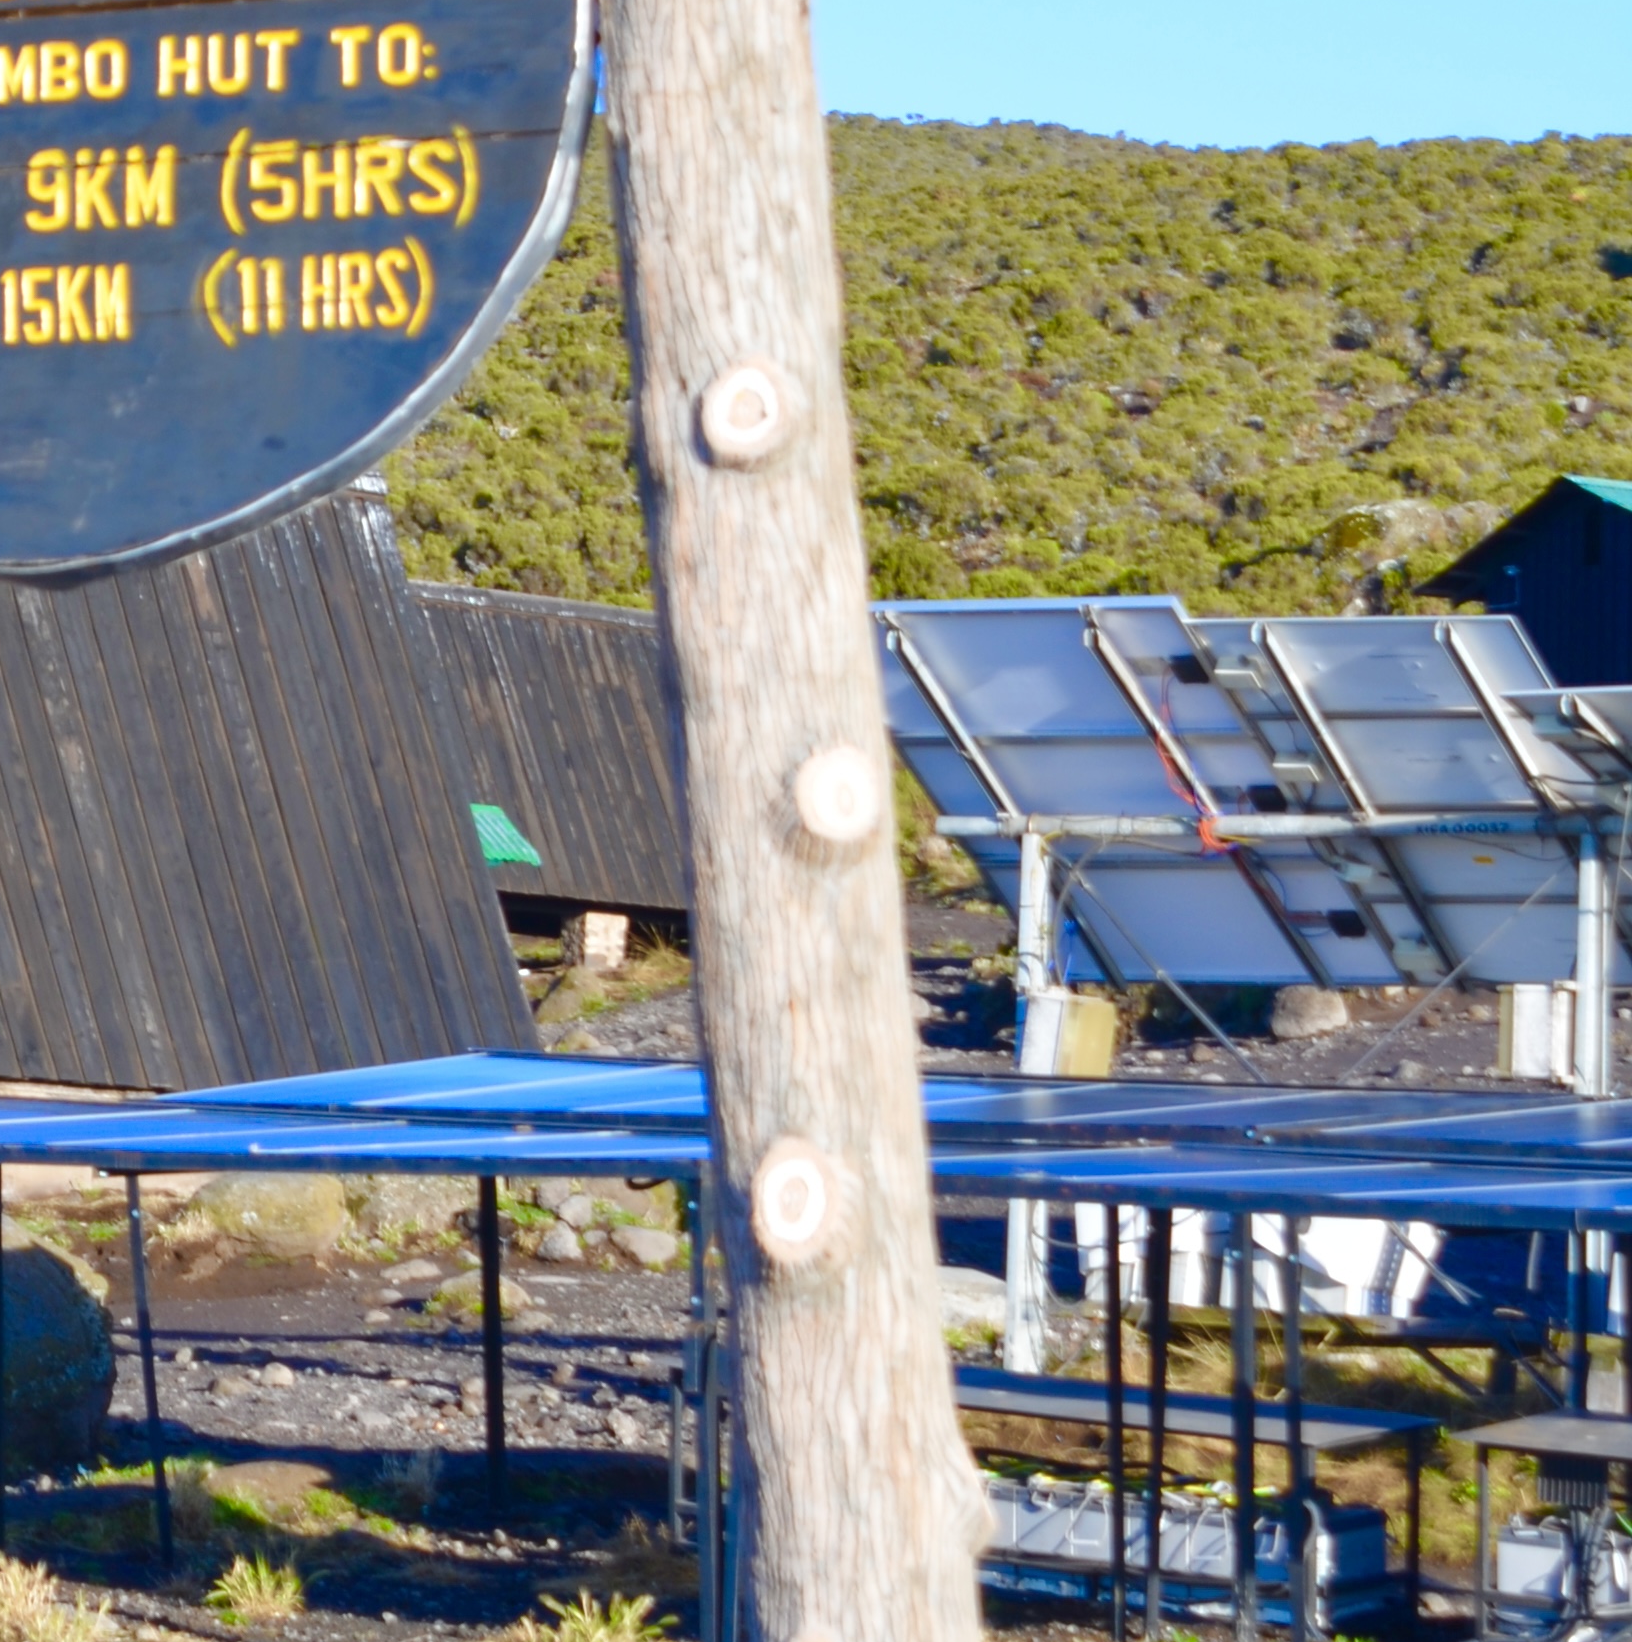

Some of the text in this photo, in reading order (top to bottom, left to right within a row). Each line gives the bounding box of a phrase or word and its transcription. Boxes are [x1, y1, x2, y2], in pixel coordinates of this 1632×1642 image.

[156, 27, 302, 99] HUT
[328, 21, 440, 89] TO:
[23, 143, 181, 235] 9KM
[218, 125, 481, 236] (5HRS)
